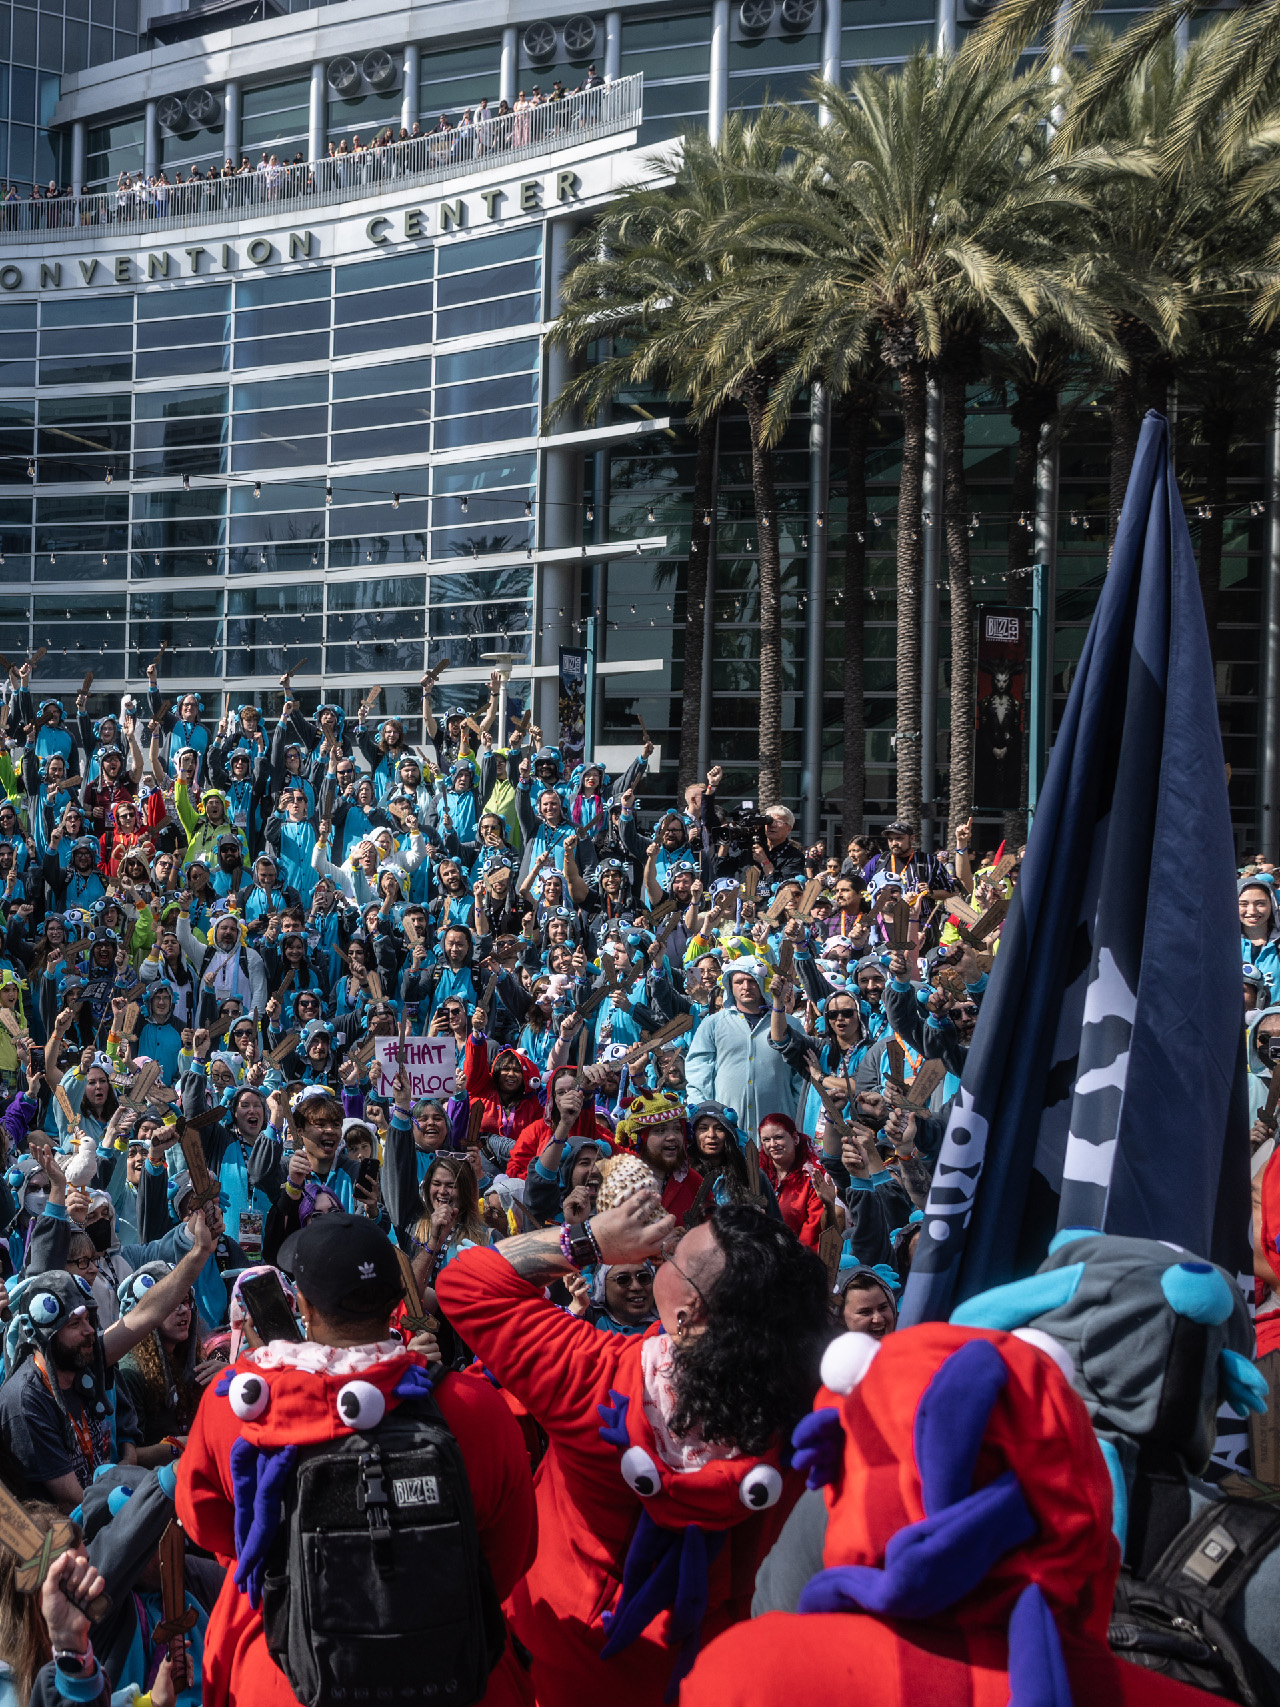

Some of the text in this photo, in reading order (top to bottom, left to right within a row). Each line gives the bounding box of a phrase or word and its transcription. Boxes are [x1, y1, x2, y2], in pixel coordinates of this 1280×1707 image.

[365, 170, 577, 244] CENTER
[988, 618, 1008, 637] BLIZZ
[383, 1042, 446, 1064] #THAT
[395, 1480, 425, 1503] BLIZZ
